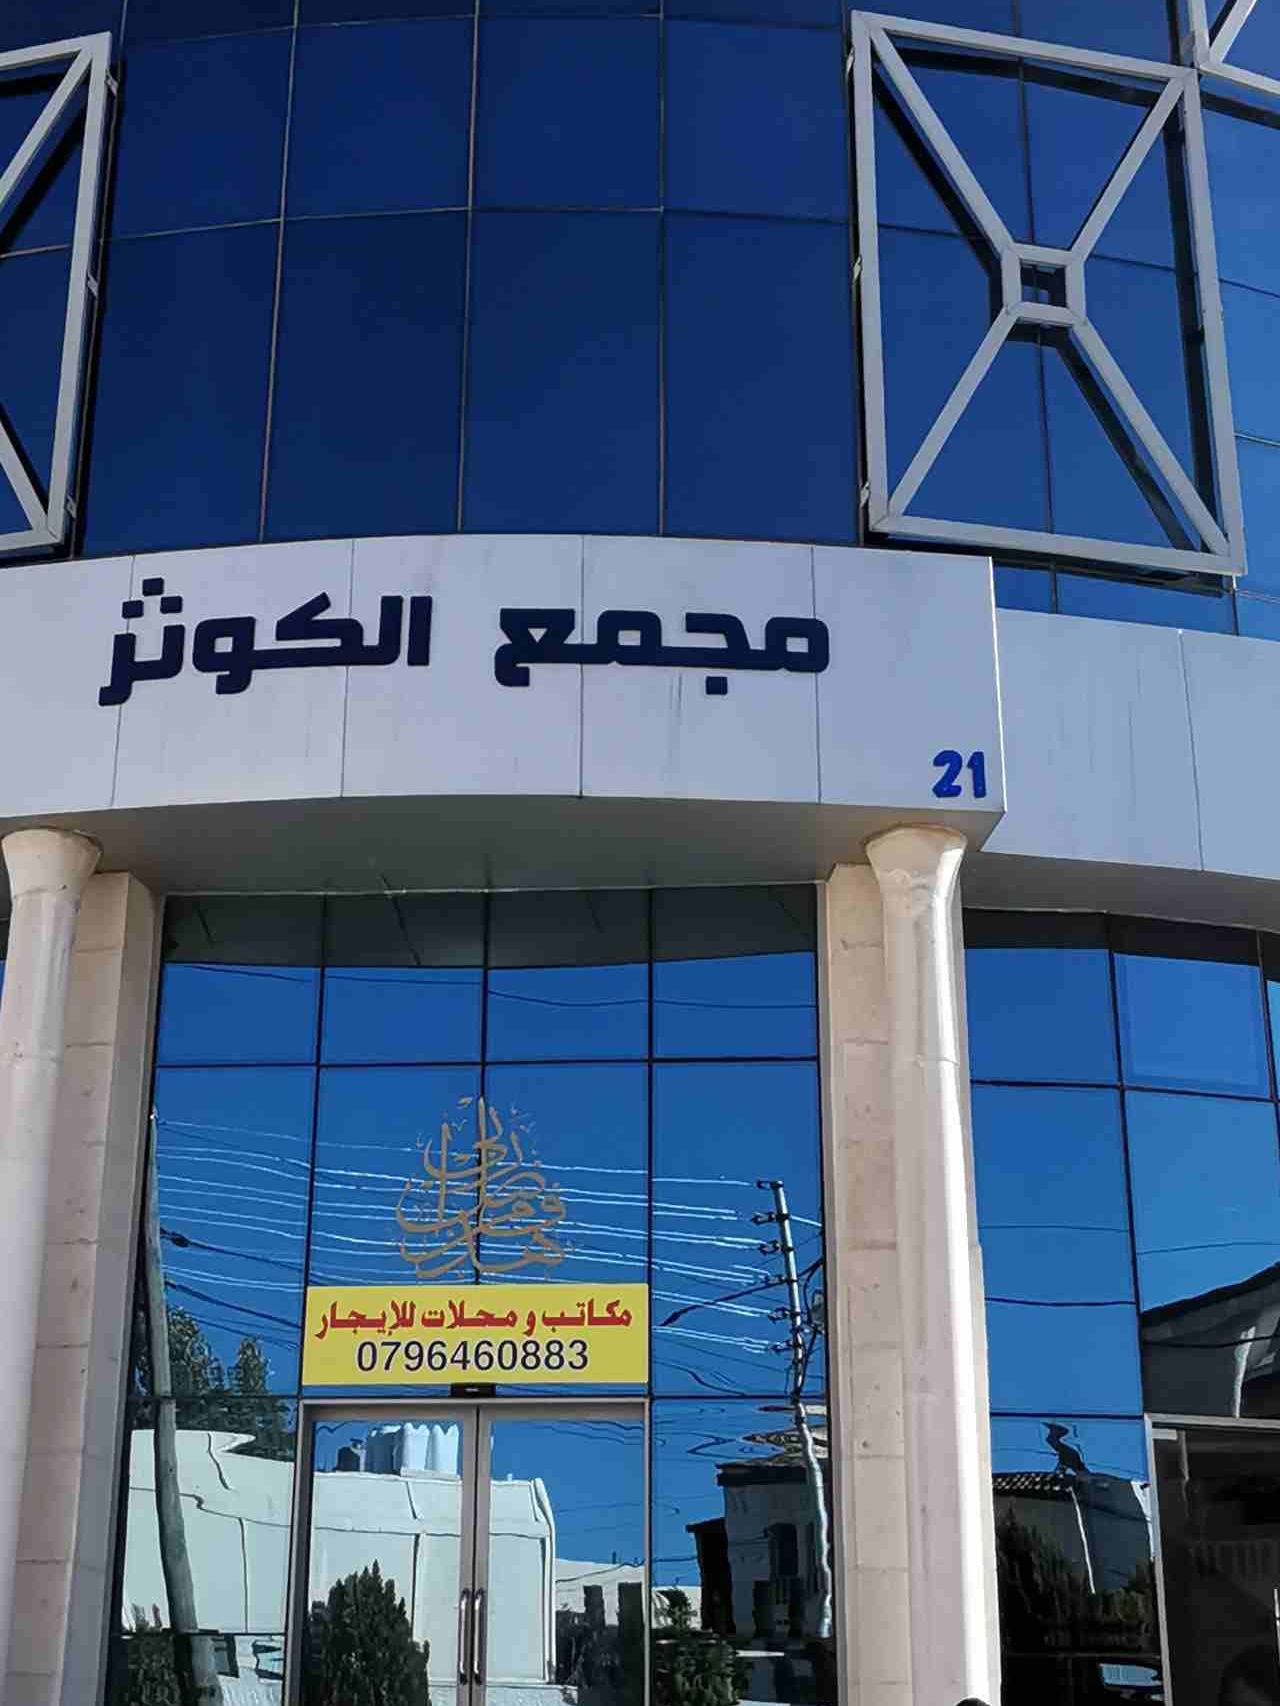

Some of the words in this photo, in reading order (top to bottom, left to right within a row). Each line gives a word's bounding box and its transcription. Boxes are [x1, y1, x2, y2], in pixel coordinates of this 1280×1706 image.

[97, 576, 434, 707] الكوثر
[493, 607, 831, 696] مجمع
[932, 749, 988, 800] 21
[314, 1299, 417, 1340] للإيجار
[420, 1299, 519, 1330] محلات
[522, 1315, 537, 1337] و
[541, 1298, 633, 1333] مكاتب
[356, 1339, 589, 1372] 0796460883
